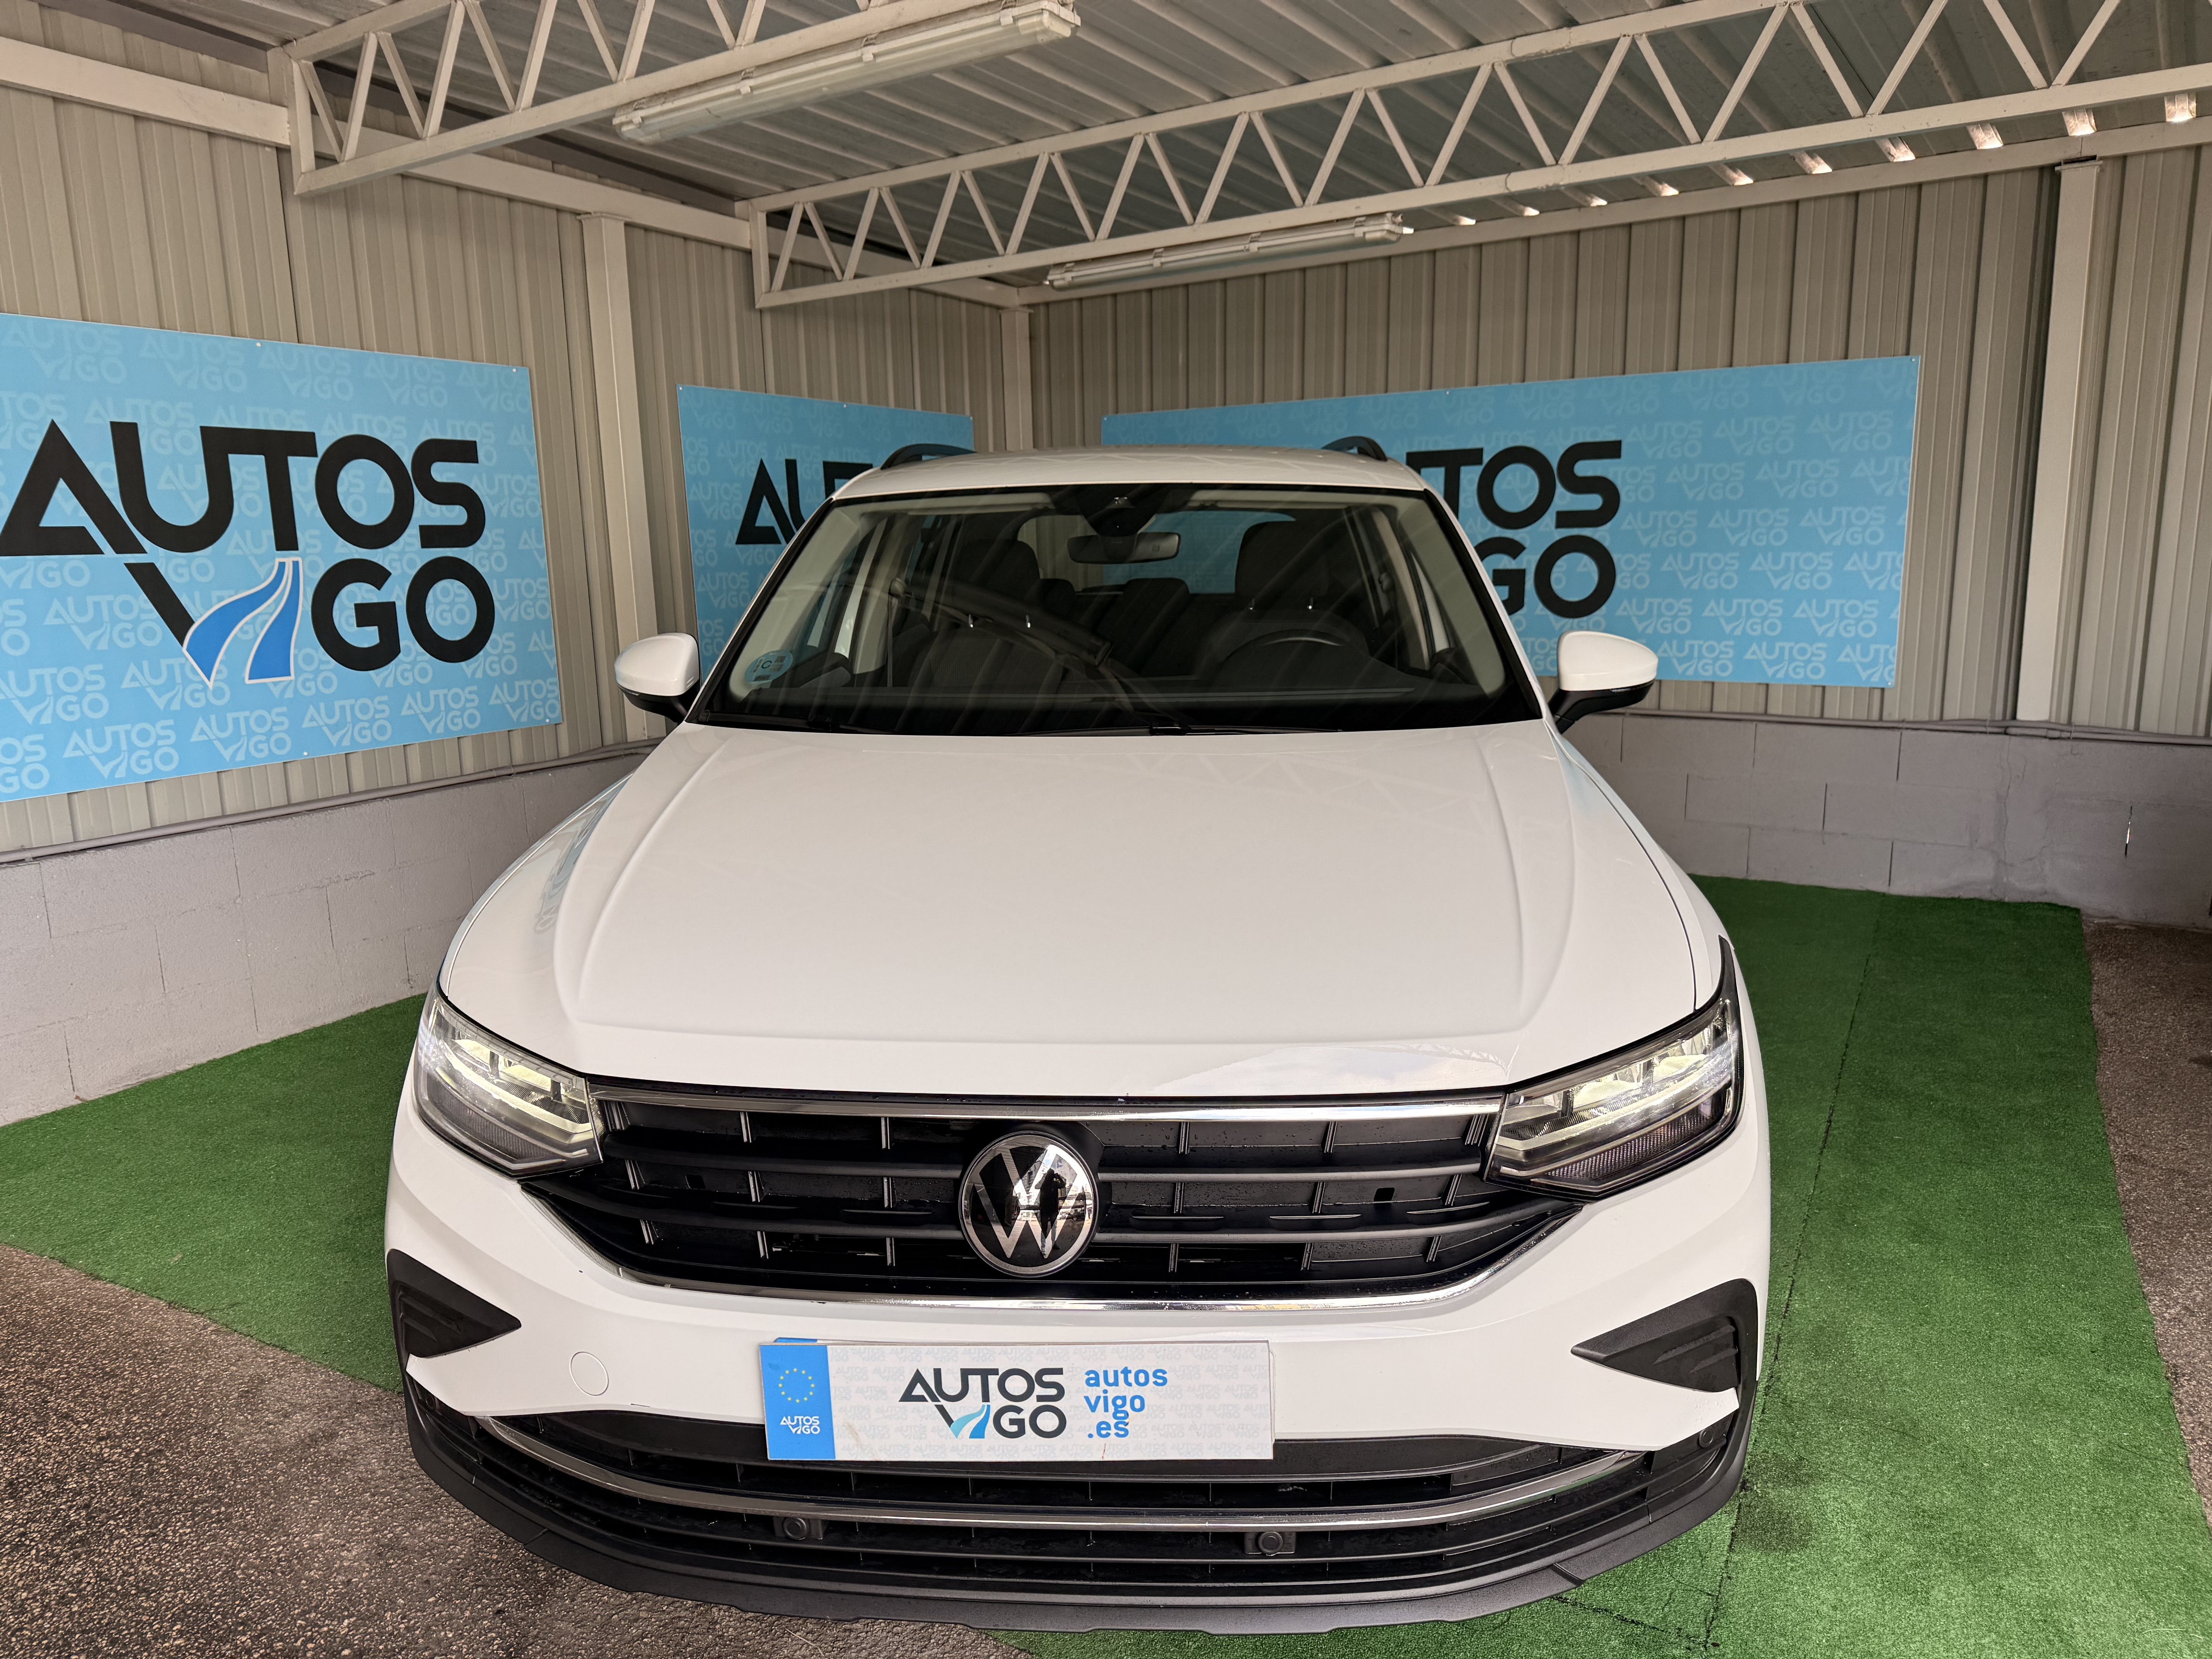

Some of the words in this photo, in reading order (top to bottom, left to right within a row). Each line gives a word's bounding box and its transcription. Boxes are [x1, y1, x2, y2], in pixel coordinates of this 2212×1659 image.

[4, 321, 122, 355] AUTOS
[139, 334, 245, 367] AUTOS
[29, 349, 127, 384] VIGO
[258, 349, 350, 376] AUTOS
[364, 357, 445, 384] AUTOS
[162, 359, 247, 393] VIGO
[1670, 371, 1750, 393] AUTOS
[1760, 363, 1847, 388] AUTOS
[280, 371, 354, 401] VIGO
[381, 379, 448, 407] VIGO
[1778, 385, 1846, 406] VIGO
[473, 388, 530, 413] VIGO
[1601, 396, 1660, 416] VIGO
[1686, 391, 1750, 410] VIGO
[693, 410, 736, 430] VIGO
[1443, 407, 1494, 426] VIGO
[1519, 402, 1575, 421] VIGO
[753, 414, 793, 434] VIGO
[1626, 421, 1703, 442] AUTOS
[1713, 415, 1796, 438] AUTOS
[1806, 410, 1894, 434] AUTOS
[716, 440, 768, 458] AUTOS
[1642, 440, 1702, 460] VIGO
[1727, 436, 1794, 456] VIGO
[1823, 431, 1893, 453] VIGO
[775, 443, 822, 463] AUTOS
[1666, 462, 1745, 483] AUTOS
[1755, 459, 1839, 481] AUTOS
[1850, 457, 1910, 478] AUT
[0, 419, 486, 556] AUTOS
[689, 481, 743, 501] AUTOS
[1682, 483, 1743, 501] VIGO
[1768, 479, 1838, 498] VIGO
[699, 501, 744, 520] VIGO
[1621, 511, 1697, 530] AUTOS
[1708, 508, 1789, 528] AUTOS
[1799, 507, 1886, 527] AUTOS
[1635, 529, 1697, 548] VIGO
[1724, 527, 1788, 546] VIGO
[1814, 526, 1884, 546] VIGO
[735, 547, 776, 566] VIGO
[1660, 553, 1740, 571] AUTOS
[1749, 551, 1834, 571] AUTOS
[492, 579, 549, 600] UTOS
[697, 572, 749, 592] AUTOS
[1675, 571, 1739, 589] VIGO
[1765, 571, 1833, 590] VIGO
[708, 590, 750, 609] VIGO
[1615, 597, 1692, 616] AUTOS
[1702, 598, 1784, 617] AUTOS
[1793, 598, 1879, 619] AUTOS
[124, 556, 495, 690] VIGO
[1632, 616, 1692, 635] VIGO
[1717, 617, 1782, 636] VIGO
[1809, 618, 1877, 638] VIGO
[71, 620, 163, 650] VIGO
[1657, 640, 1735, 658] AUTOS
[1743, 641, 1827, 660] AUTOS
[761, 660, 772, 669] C
[1672, 658, 1733, 676] VIGO
[1760, 661, 1826, 680] VIGO
[147, 682, 230, 711] VIGO
[401, 686, 479, 716] AUTOS
[489, 678, 559, 705] AUTOS
[11, 693, 109, 725] VIGO
[302, 696, 389, 728] AUTOS
[505, 699, 561, 722] VIGO
[189, 707, 289, 742] AUTOS
[419, 708, 481, 733] VIGO
[63, 720, 176, 758] AUTOS
[322, 720, 392, 747] VIGO
[213, 732, 292, 761] VIGO
[89, 746, 179, 778] VIGO
[898, 1368, 1065, 1402] AUTOS
[1085, 1367, 1168, 1387] autos
[1084, 1389, 1145, 1420] vigo
[780, 1416, 819, 1425] AUTOS
[788, 1425, 820, 1434] VIGO
[934, 1405, 1066, 1439] VIGO
[1088, 1421, 1129, 1438] .es
